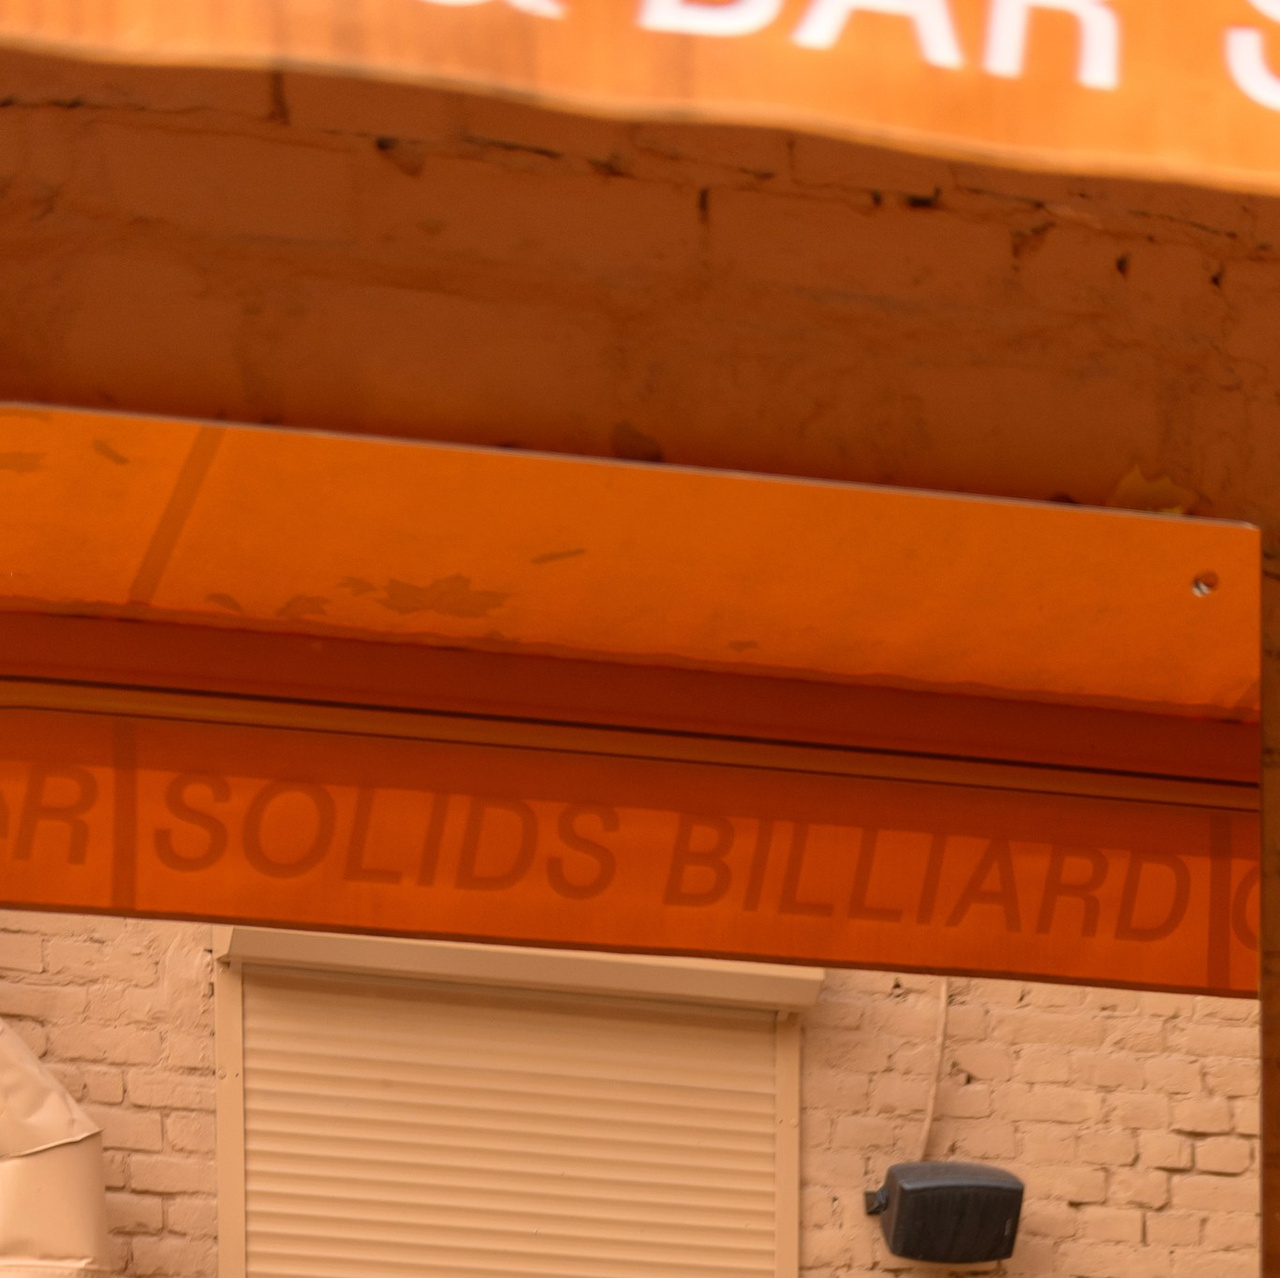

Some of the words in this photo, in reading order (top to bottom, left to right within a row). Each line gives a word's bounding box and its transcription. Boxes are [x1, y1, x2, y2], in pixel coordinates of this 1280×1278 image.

[0, 762, 98, 866] R
[153, 773, 620, 900] SOLIDS
[663, 811, 1192, 942] BILLIARD
